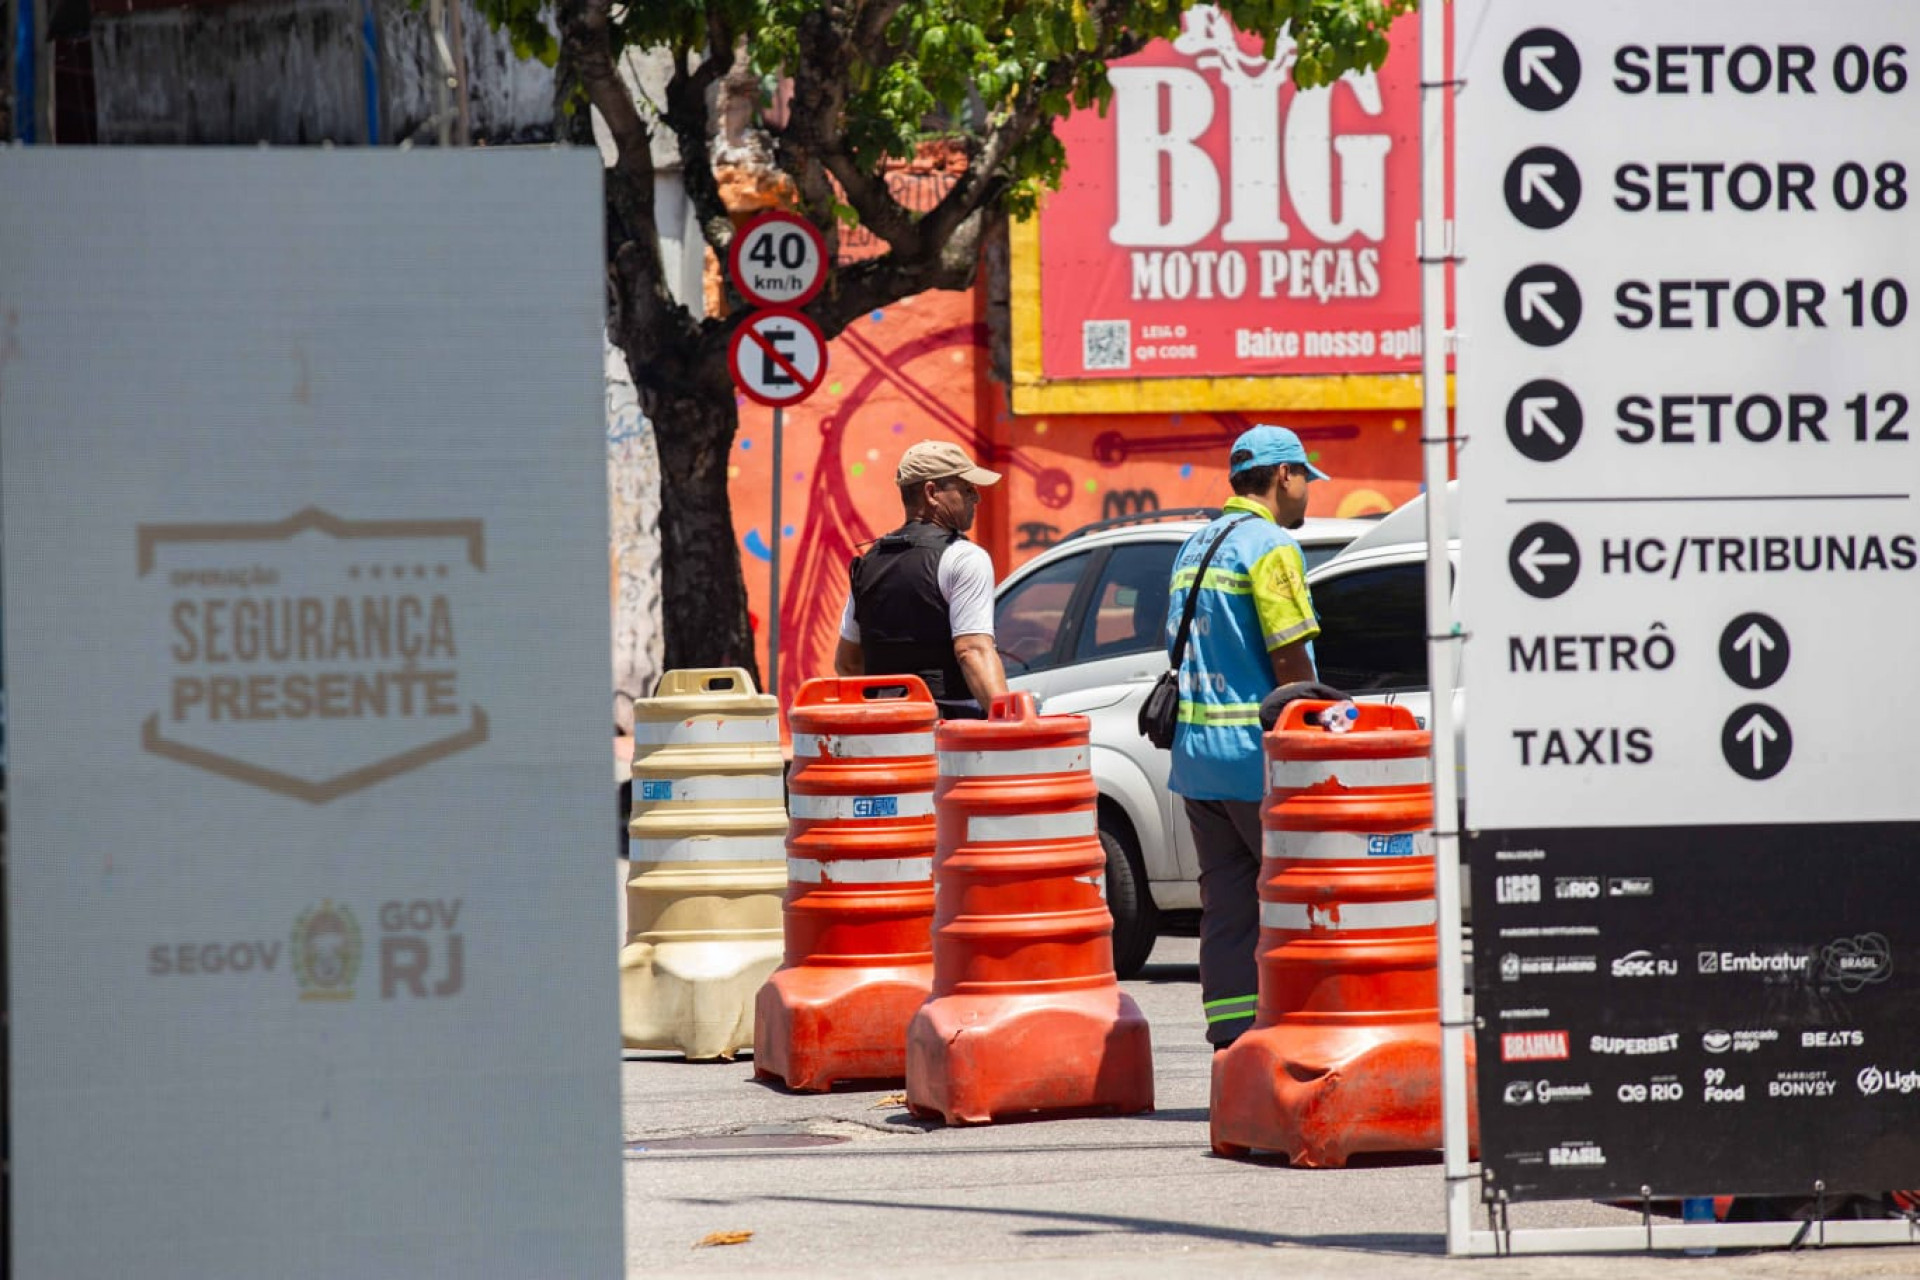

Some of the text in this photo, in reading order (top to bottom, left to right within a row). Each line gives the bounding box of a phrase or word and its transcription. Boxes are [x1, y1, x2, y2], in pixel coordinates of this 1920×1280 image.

[1613, 43, 1908, 94] SETOR 06
[1106, 65, 1392, 247] BIG
[1613, 161, 1908, 212] SETOR 08
[748, 232, 806, 269] 40
[754, 274, 803, 291] km/h
[1130, 248, 1380, 303] MOTO PEÇAS
[1614, 278, 1908, 329] SETOR 10
[1141, 325, 1187, 339] LEIA O
[1235, 326, 1300, 359] Baixe
[1304, 330, 1375, 358] nosso
[762, 331, 796, 385] E
[1135, 344, 1198, 360] QR CODE
[1615, 392, 1910, 444] SETOR 12
[1601, 534, 1918, 581] HC/TRIBUNAS
[171, 594, 458, 668] SEGURANÇA
[1509, 621, 1676, 673] METRÔ
[171, 670, 459, 722] PRESENTE
[1512, 727, 1654, 766] TAXIS
[1569, 881, 1600, 898] RIO
[379, 899, 463, 932] GOV
[149, 941, 281, 976] SEGOV
[380, 934, 465, 1001] RJ
[1658, 959, 1678, 976] RJ
[1721, 952, 1810, 972] Embratur
[1840, 957, 1879, 969] BRASIL
[1503, 1033, 1567, 1059] BRAHMA
[1590, 1033, 1679, 1054] SUPERBET
[1801, 1030, 1864, 1047] BEATS
[1651, 1083, 1683, 1101] RIO
[1704, 1068, 1726, 1085] 99
[1769, 1081, 1836, 1097] BONVOY
[1885, 1070, 1920, 1094] Ligh
[1704, 1085, 1745, 1102] Food
